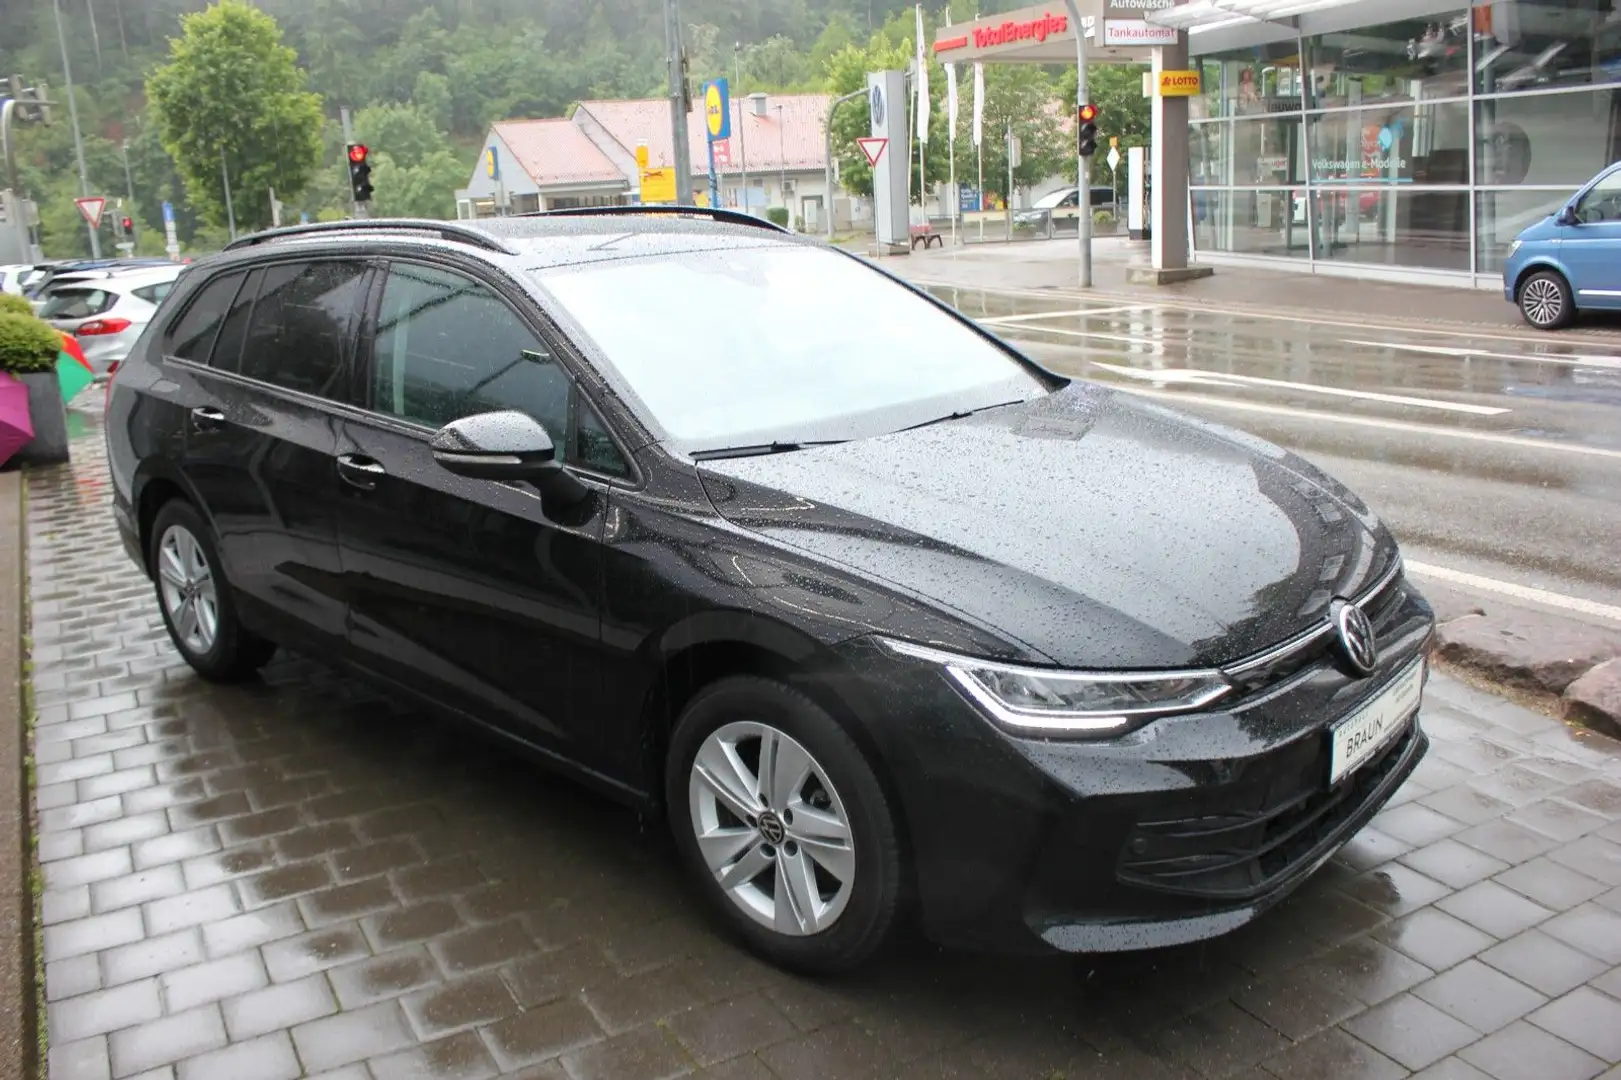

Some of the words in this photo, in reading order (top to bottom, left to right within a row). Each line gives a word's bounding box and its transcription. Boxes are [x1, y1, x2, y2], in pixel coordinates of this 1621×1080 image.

[972, 11, 1067, 48] TotalEnergies
[1108, 26, 1175, 38] Tankautomat
[1172, 76, 1199, 87] LOTTO
[1312, 158, 1360, 171] Volkswagen
[1345, 714, 1384, 758] BRAUN
